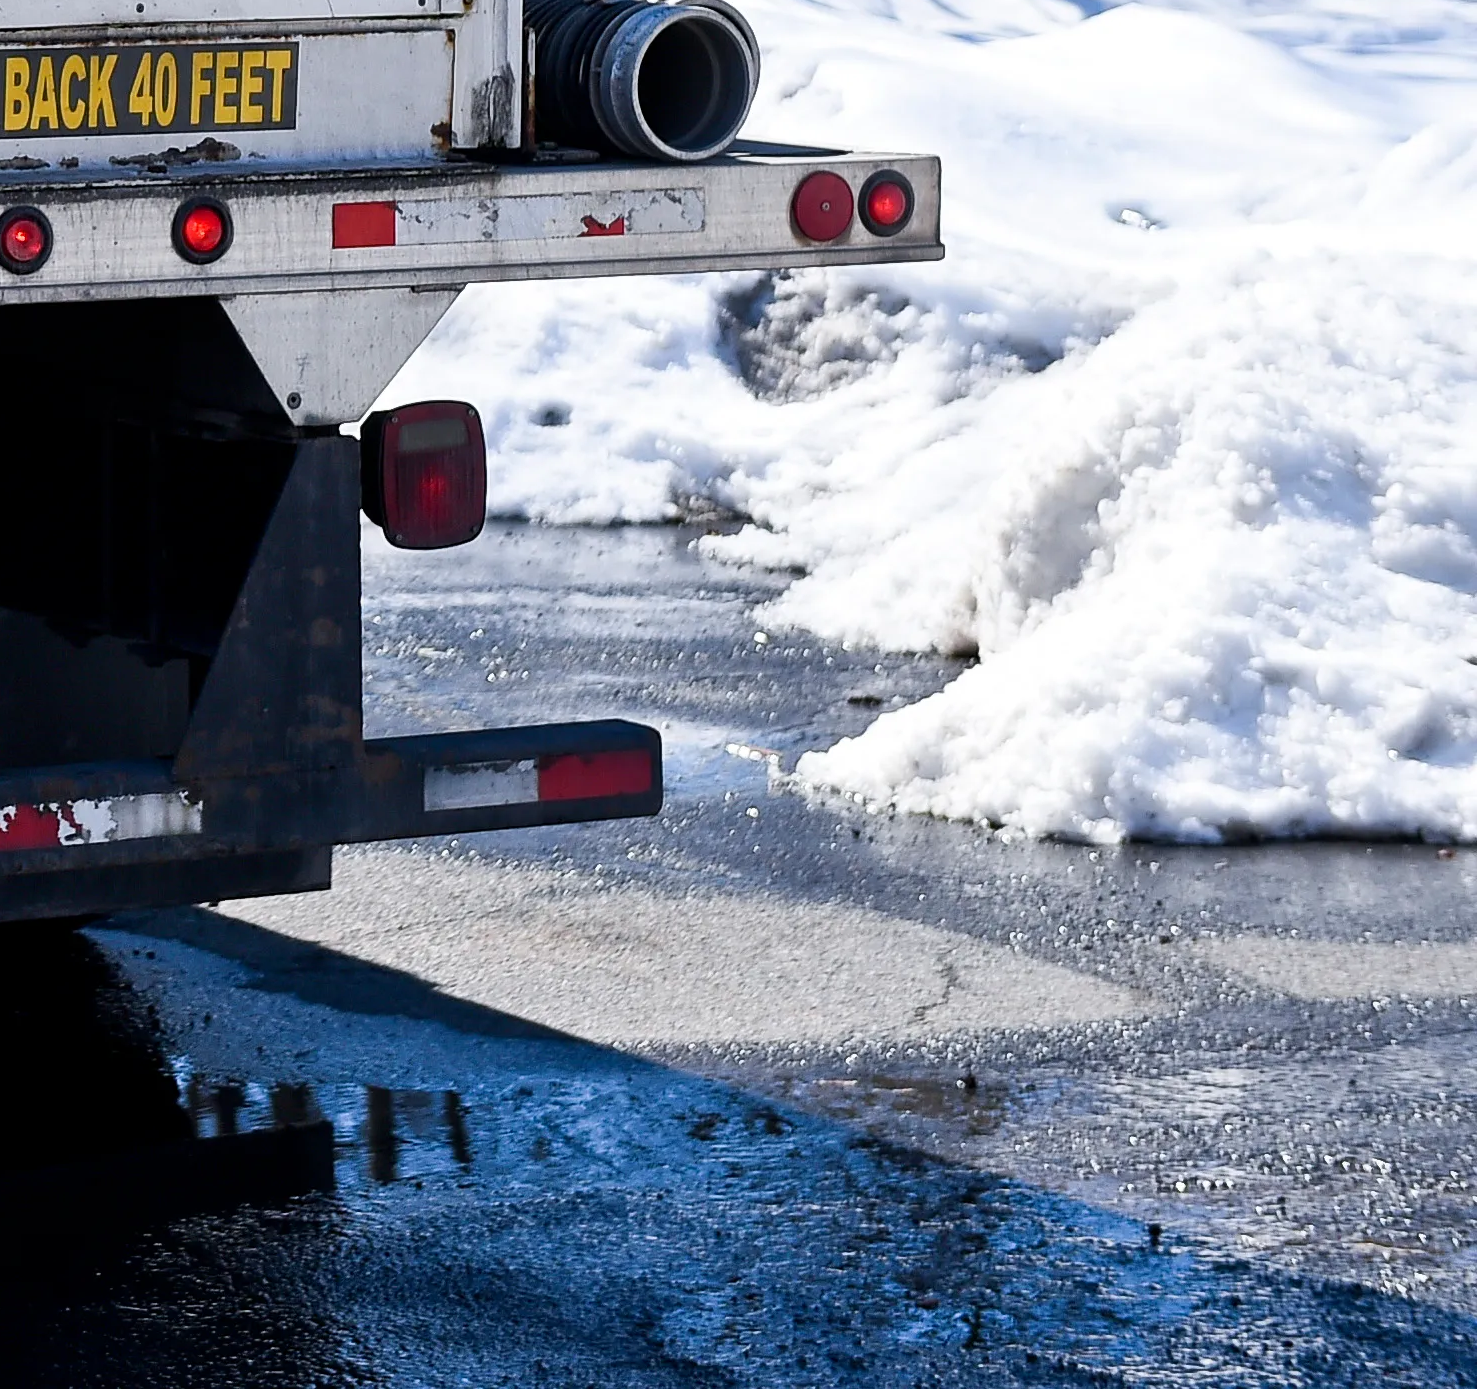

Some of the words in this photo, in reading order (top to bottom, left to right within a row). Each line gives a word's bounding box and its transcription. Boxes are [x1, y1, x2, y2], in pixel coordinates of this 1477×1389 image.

[4, 54, 118, 131] BACK
[129, 52, 177, 127] 40
[190, 50, 293, 125] FEET
